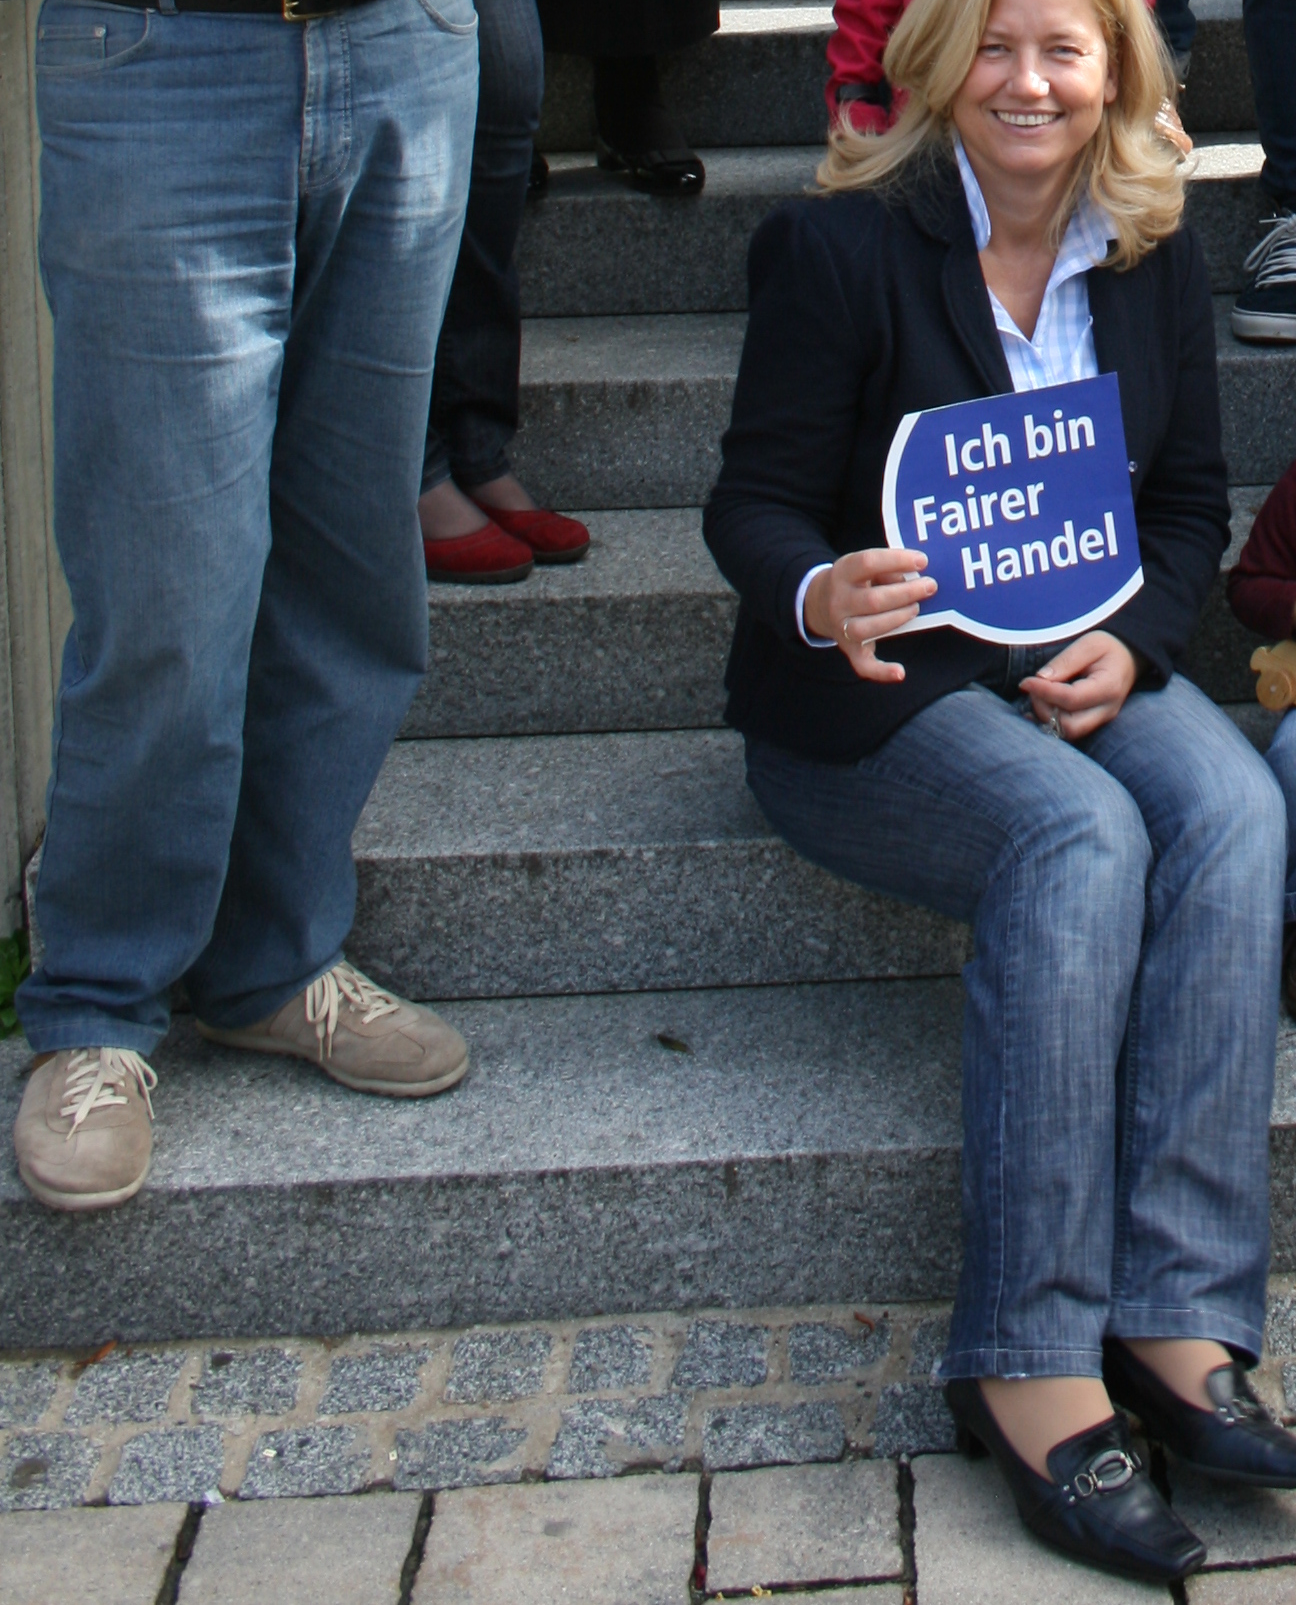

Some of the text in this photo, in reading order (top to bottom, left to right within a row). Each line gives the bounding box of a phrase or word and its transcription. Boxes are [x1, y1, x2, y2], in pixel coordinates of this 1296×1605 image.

[945, 409, 1096, 476] Ich bin
[913, 481, 1045, 542] Fairer
[960, 511, 1119, 590] Handel
